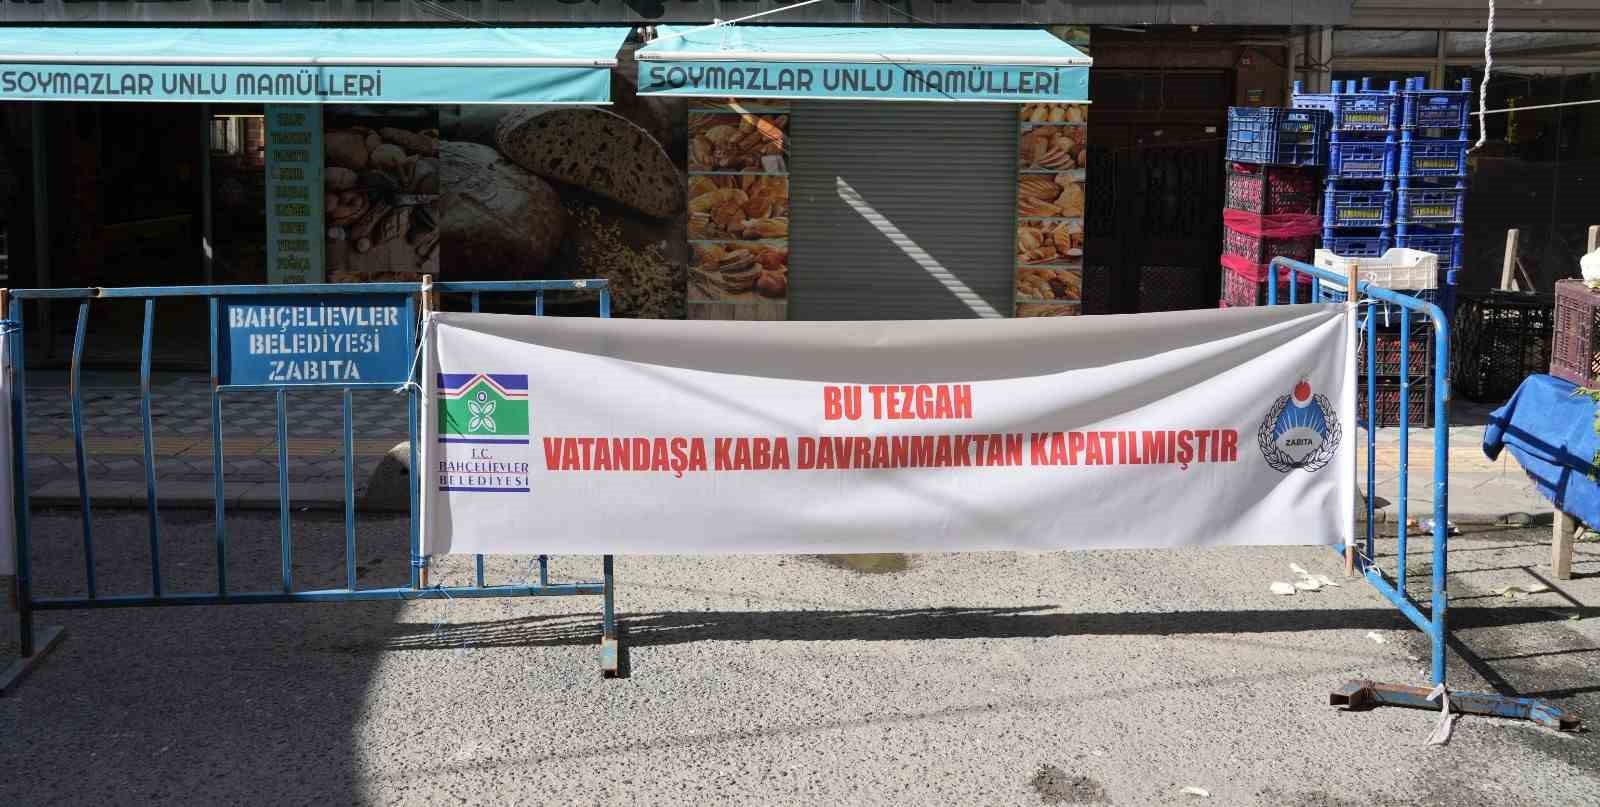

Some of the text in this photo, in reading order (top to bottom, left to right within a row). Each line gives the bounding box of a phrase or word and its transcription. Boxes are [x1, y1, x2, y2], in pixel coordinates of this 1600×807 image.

[2, 69, 382, 97] SOYMAZLAR UNLU MAMÜLLERİ
[650, 64, 1062, 95] SOYMAZLAR UNLU MAMÜLLERİ
[228, 302, 398, 331] BAHÇELİEVLER
[249, 328, 380, 354] BELEDİYESİ
[268, 360, 361, 382] ZABITA
[823, 384, 973, 421] BU TEZGAH
[543, 429, 1238, 478] VATANDAŞA KABA DAVRANMAKTAN KAPATILMIŞTIR
[1285, 438, 1313, 447] ZABITA
